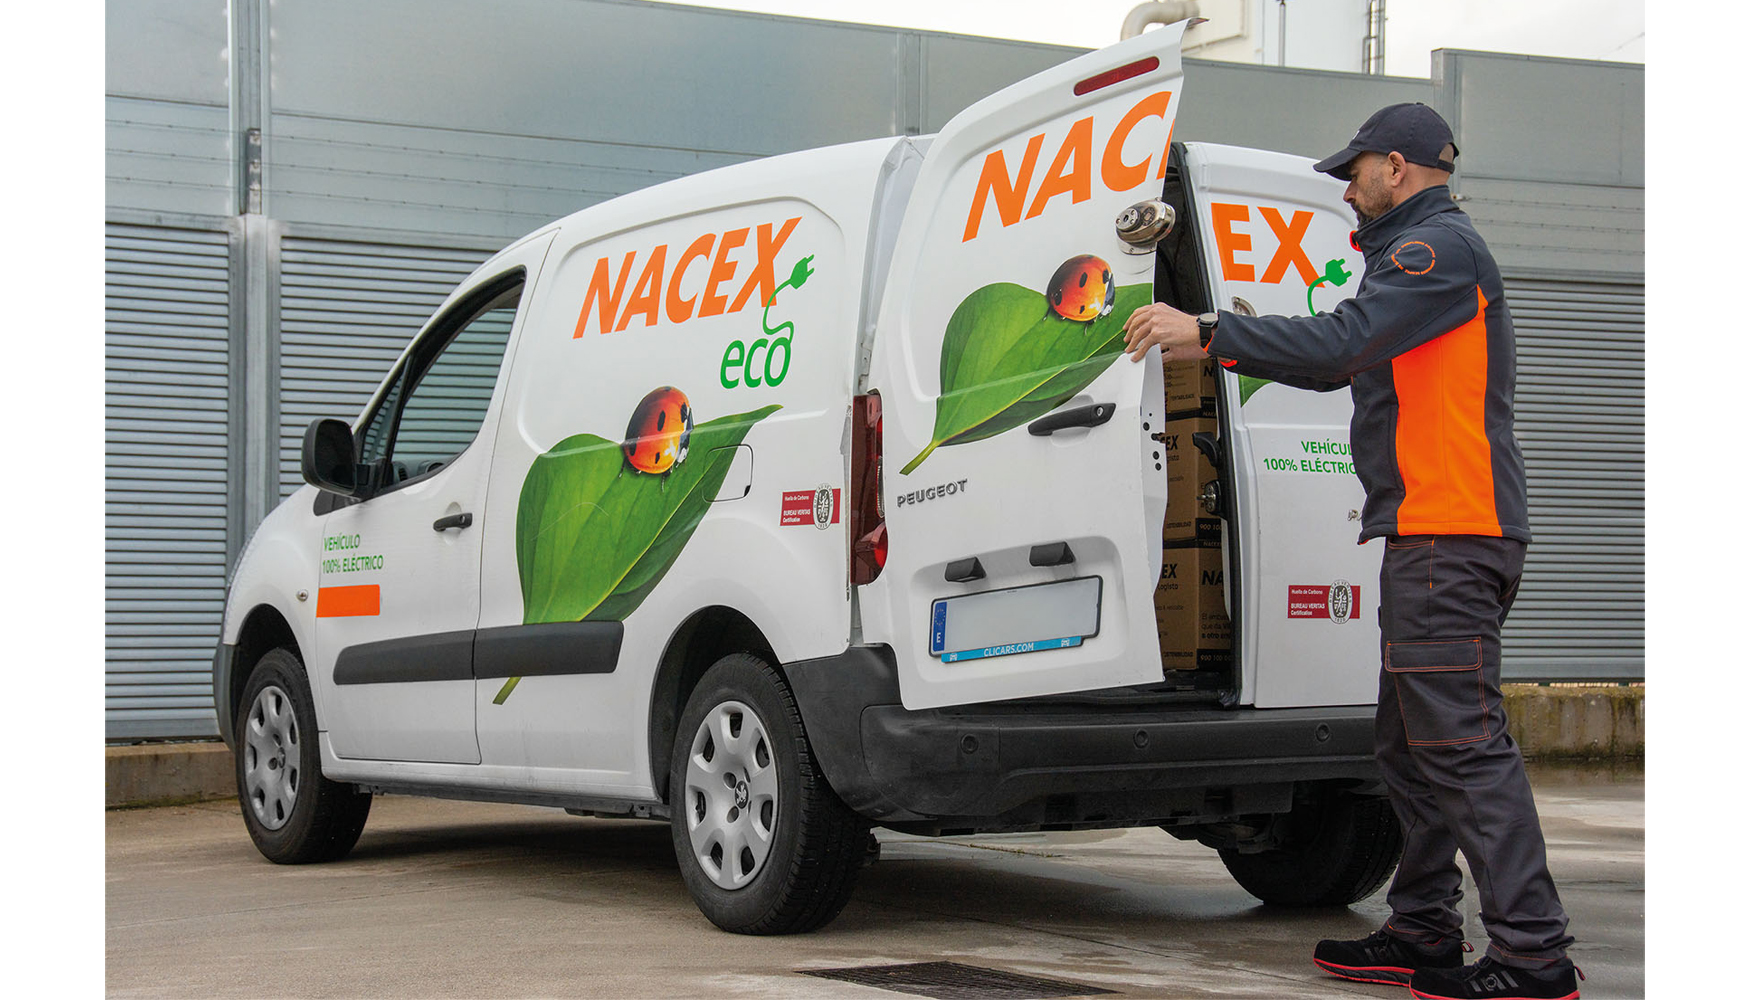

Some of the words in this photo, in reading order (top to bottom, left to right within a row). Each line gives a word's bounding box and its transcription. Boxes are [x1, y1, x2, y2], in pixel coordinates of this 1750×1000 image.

[962, 91, 1175, 243] NAC
[1210, 202, 1326, 289] EX
[572, 216, 803, 340] NACEX
[720, 336, 792, 389] eco
[1263, 458, 1298, 472] 100%
[896, 478, 968, 508] PEUGEOT
[323, 532, 361, 551] VEHÍCULO
[322, 558, 341, 574] 100%
[342, 553, 384, 572] ELÉCTRICO
[936, 632, 942, 644] E
[983, 643, 1035, 658] CLICARS.COM
